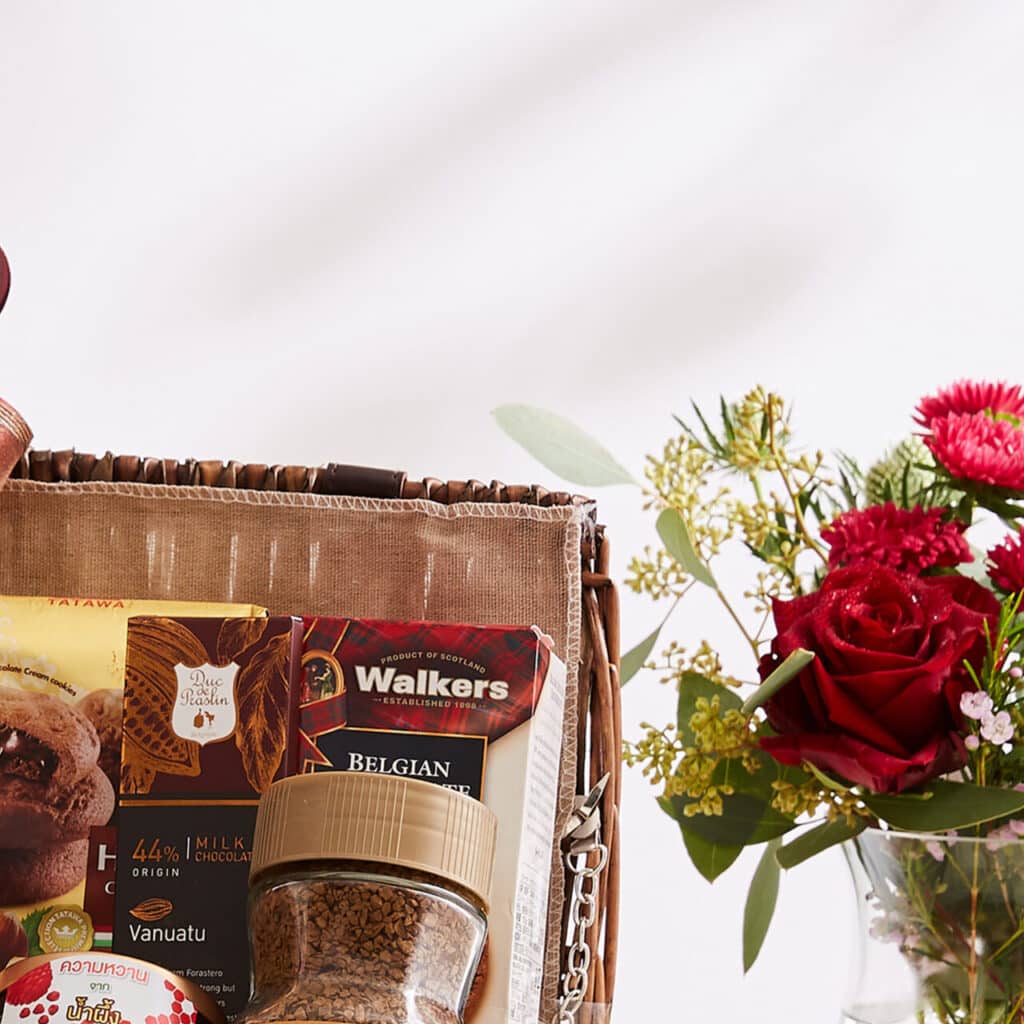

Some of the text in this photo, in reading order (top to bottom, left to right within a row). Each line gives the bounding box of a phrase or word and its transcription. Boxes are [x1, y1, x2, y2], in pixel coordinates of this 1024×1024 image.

[380, 651, 486, 675] PRODUCT OF SCOTLAND
[24, 667, 49, 682] Cream
[50, 677, 77, 697] cookies
[190, 669, 224, 687] Duc
[354, 665, 510, 701] Walkers
[382, 697, 451, 708] ESTABLISHED
[347, 752, 452, 778] BELGIAN
[131, 836, 244, 863] 44% MILK
[132, 867, 180, 878] ORIGIN
[129, 924, 206, 942] Vanuatu
[60, 960, 149, 985] ความหวาน
[186, 968, 224, 978] Forastero
[90, 982, 110, 992] จาก
